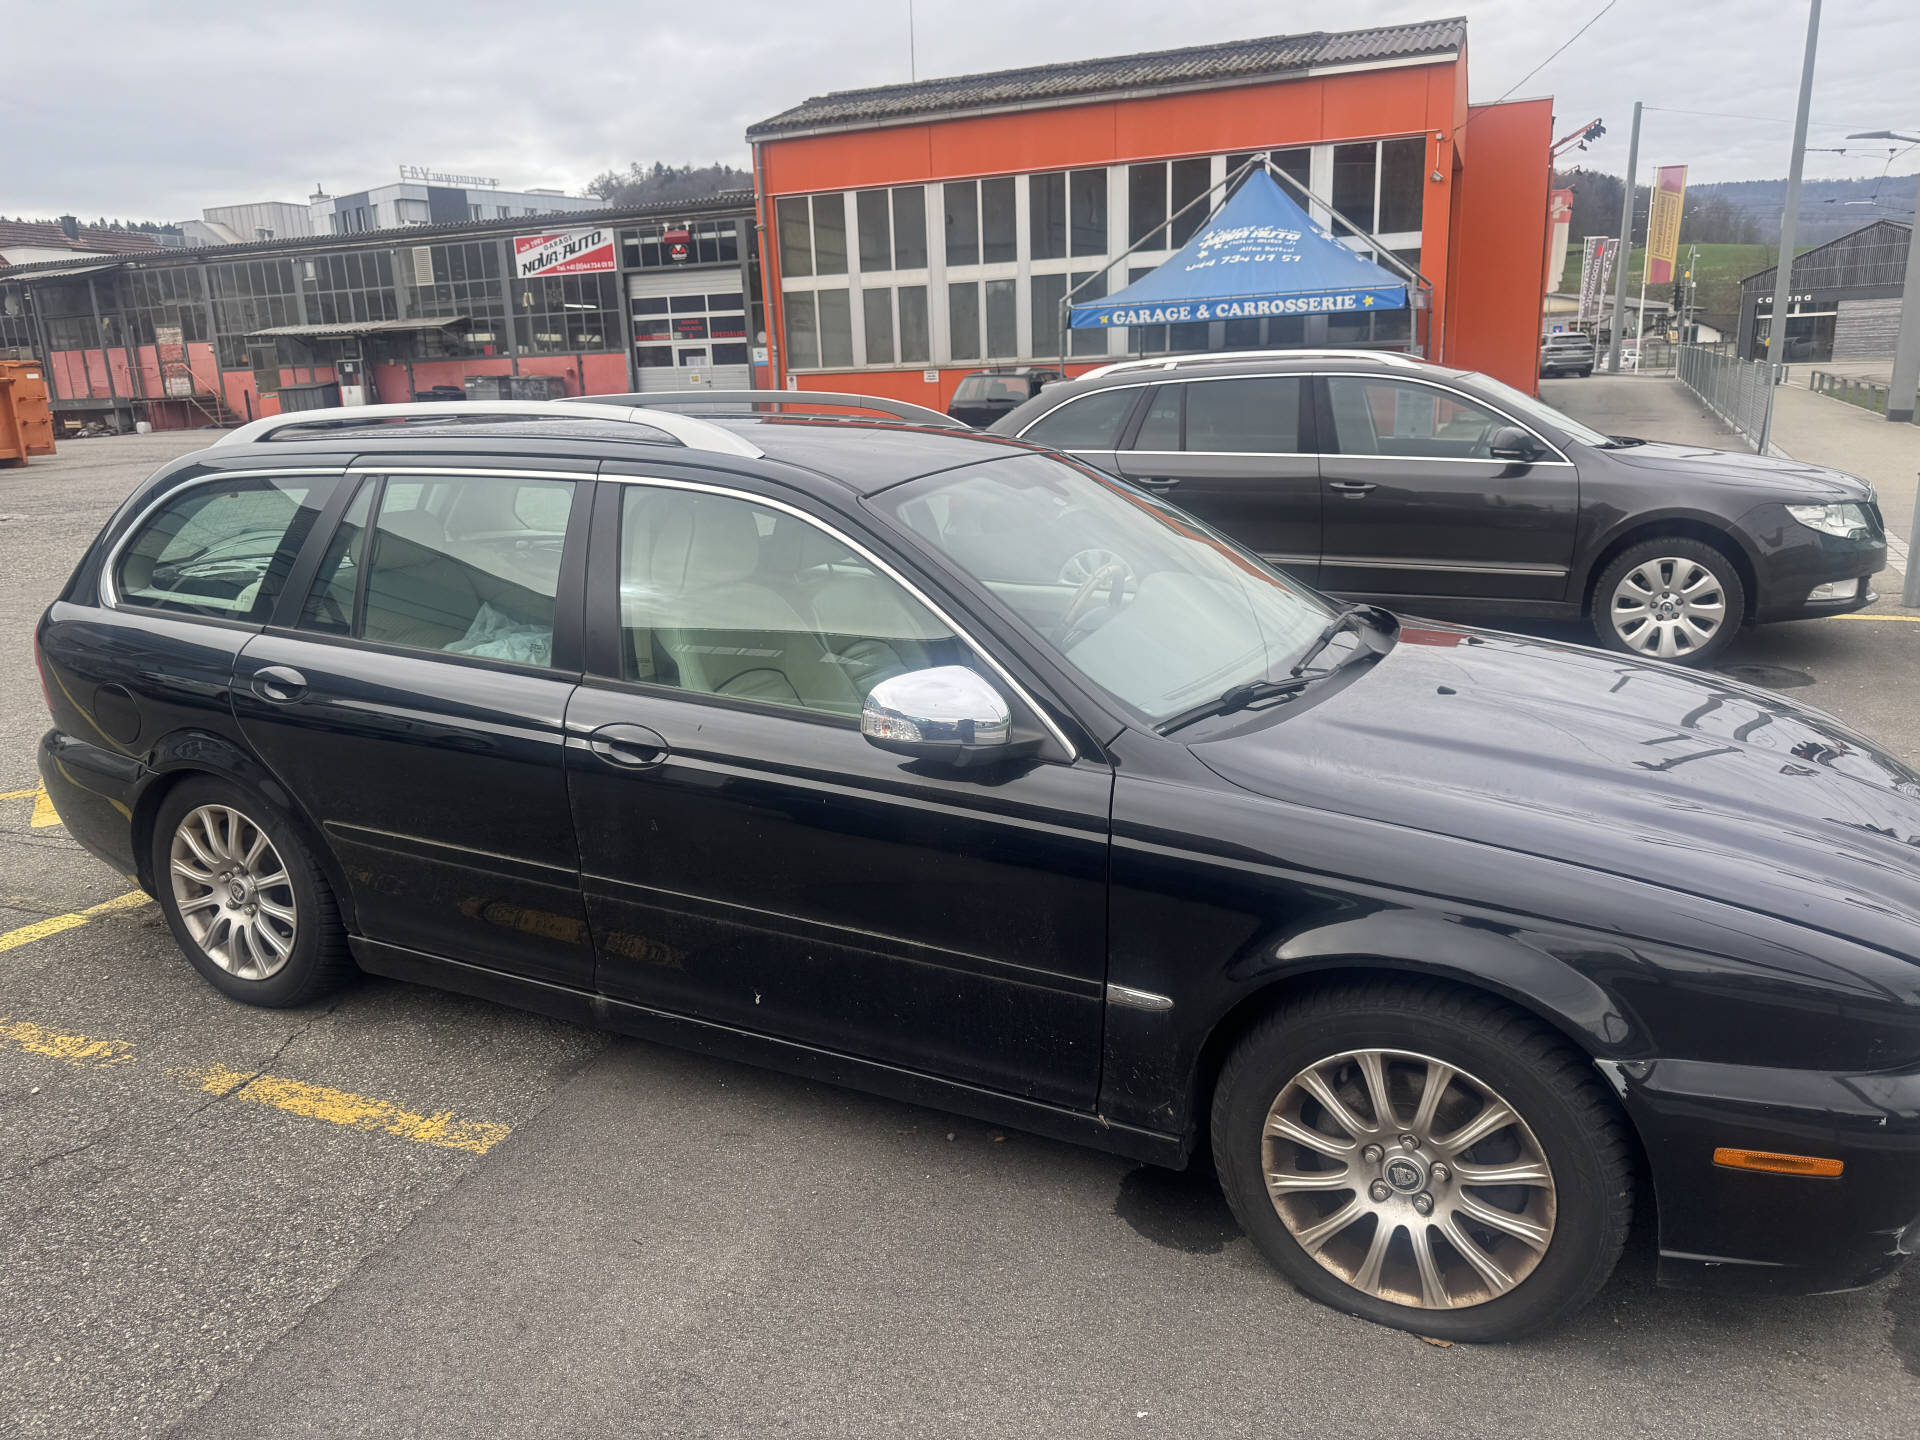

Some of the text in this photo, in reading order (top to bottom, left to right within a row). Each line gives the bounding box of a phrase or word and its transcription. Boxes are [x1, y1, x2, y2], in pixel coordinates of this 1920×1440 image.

[543, 235, 573, 251] GARAGE
[1112, 295, 1357, 325] GARAGE & CARROSSERIE
